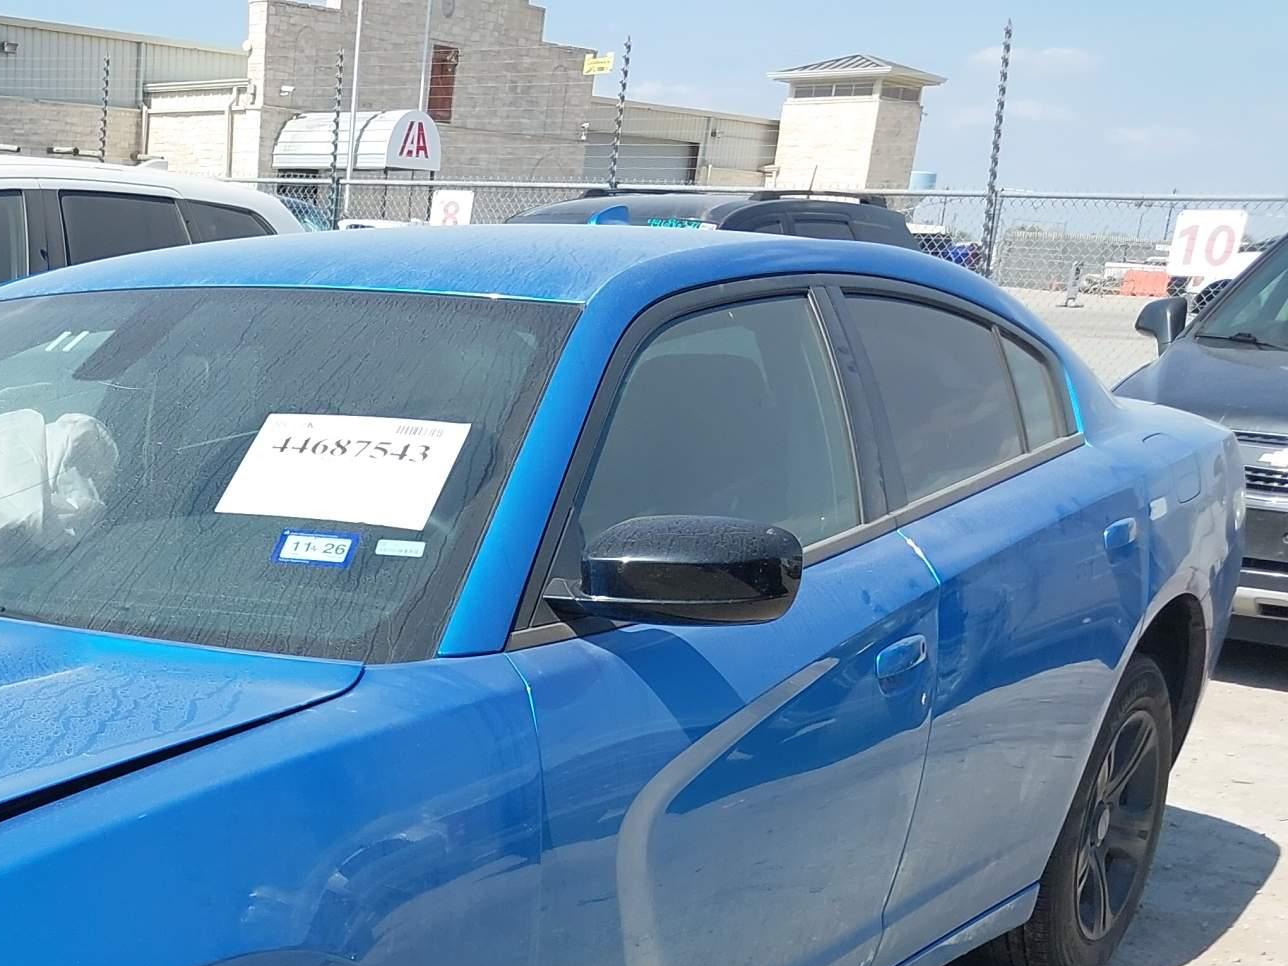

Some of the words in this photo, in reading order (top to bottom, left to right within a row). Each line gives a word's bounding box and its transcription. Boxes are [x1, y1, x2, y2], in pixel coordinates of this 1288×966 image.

[442, 200, 460, 225] 8
[1178, 224, 1236, 267] 10
[272, 435, 432, 463] 44687543
[322, 542, 347, 555] 26
